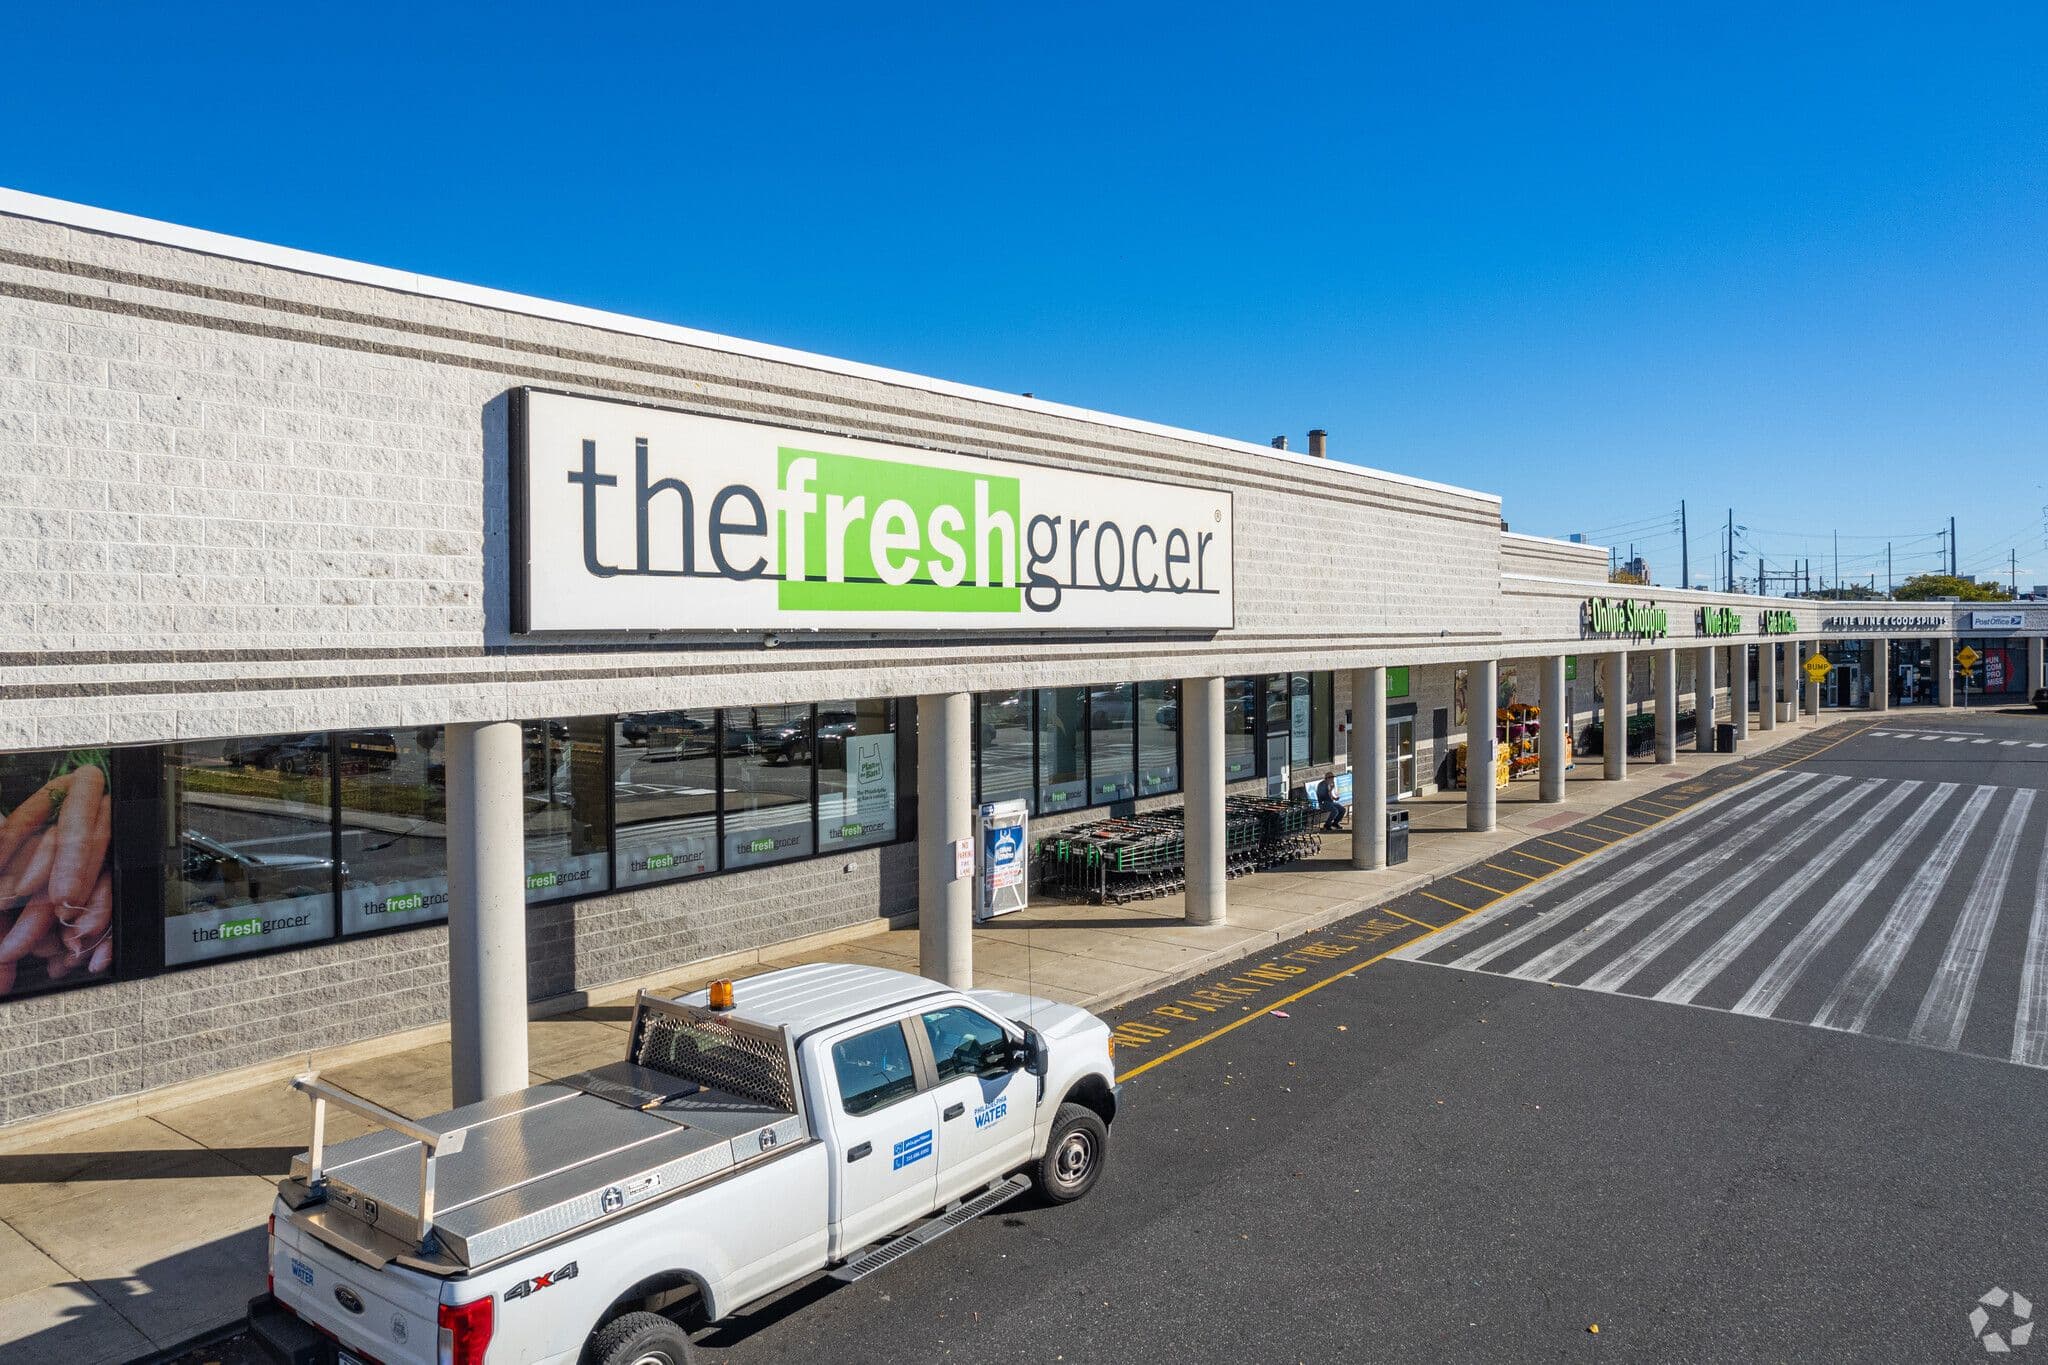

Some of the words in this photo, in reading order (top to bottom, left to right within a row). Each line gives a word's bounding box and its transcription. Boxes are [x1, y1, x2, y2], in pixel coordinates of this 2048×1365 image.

[1592, 597, 1625, 633] Online
[1626, 598, 1667, 639] Shopping
[1704, 606, 1721, 633] Wine
[1729, 608, 1742, 633] Beer
[1833, 616, 1855, 626] FINE
[1857, 616, 1881, 626] WINE
[1883, 616, 1889, 626] &
[1891, 616, 1914, 626] GOOD
[1916, 616, 1948, 626] SPIRITS
[1975, 617, 1990, 625] Post
[1990, 617, 2010, 625] Office
[1806, 663, 1829, 671] BUMP
[1986, 663, 2002, 672] COM
[1986, 671, 2001, 679] PRO
[1987, 678, 2004, 686] MISE
[526, 867, 592, 889] freshgrocer
[1151, 962, 1307, 1022] PARKING
[974, 1103, 1007, 1128] WATER
[291, 1264, 314, 1287] WATER
